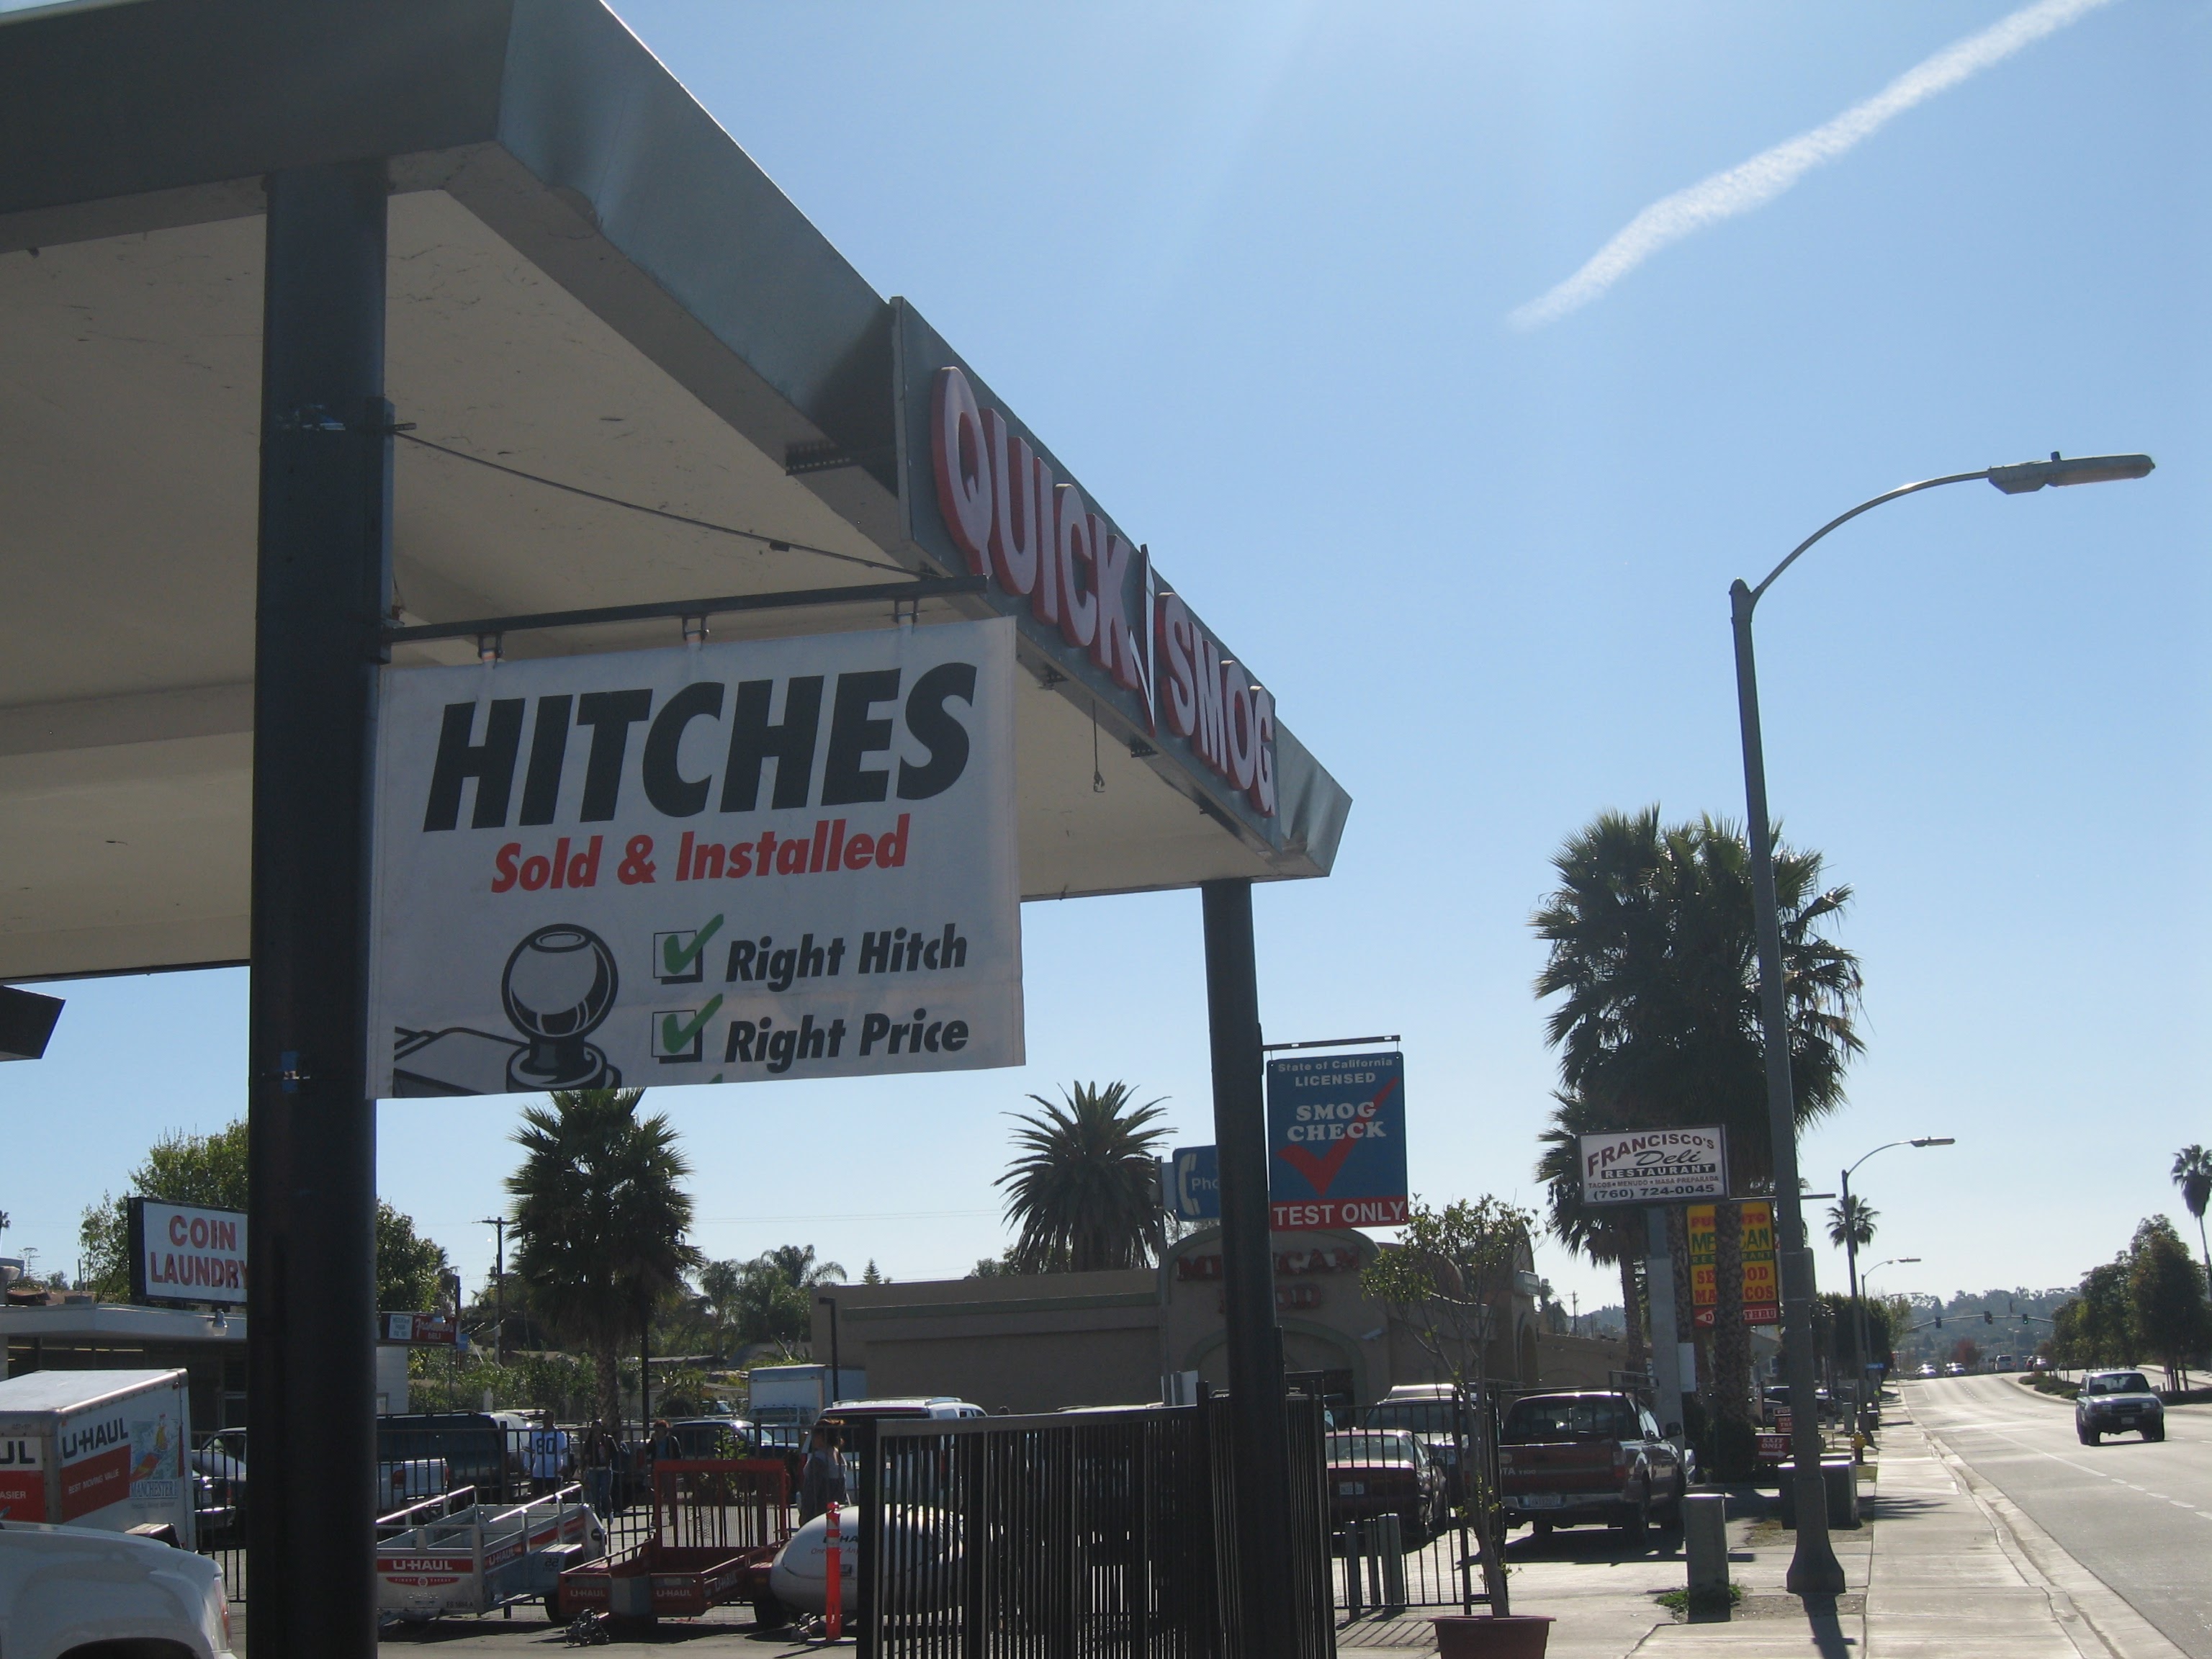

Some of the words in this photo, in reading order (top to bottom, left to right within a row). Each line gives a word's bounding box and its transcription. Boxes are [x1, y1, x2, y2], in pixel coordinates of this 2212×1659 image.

[931, 366, 1138, 691] QUICK
[1155, 591, 1275, 817] SMOG
[423, 662, 977, 832] HITCHES
[491, 835, 603, 893] Sold
[617, 835, 656, 885] &
[675, 814, 911, 882] Installed
[726, 935, 845, 992] Right
[859, 923, 966, 974] Hitch
[724, 1015, 845, 1073] Right
[860, 1009, 968, 1056] Price
[1278, 1063, 1312, 1072] State
[1316, 1061, 1328, 1070] of
[1332, 1058, 1393, 1069] California
[1295, 1072, 1376, 1087] LICENSED
[1297, 1102, 1376, 1121] SMOG
[1287, 1121, 1386, 1142] CHECK
[1588, 1133, 1714, 1177] FRANCISCO'S
[1634, 1149, 1701, 1166] Deli
[1606, 1164, 1712, 1179] RESTAURANT
[1192, 1177, 1219, 1190] Pho
[1593, 1189, 1634, 1201] (760)
[1640, 1184, 1714, 1197] 724-0045
[1273, 1205, 1334, 1226] TEST
[1341, 1200, 1403, 1223] ONLY
[169, 1215, 235, 1251] COIN
[150, 1251, 248, 1290] LAUNDRY
[1745, 1310, 1775, 1319] THRU
[62, 1417, 130, 1459] U-HAUL
[536, 1437, 556, 1455] 80
[392, 1560, 453, 1570] U-HAUL
[489, 1546, 515, 1566] U-HAUL
